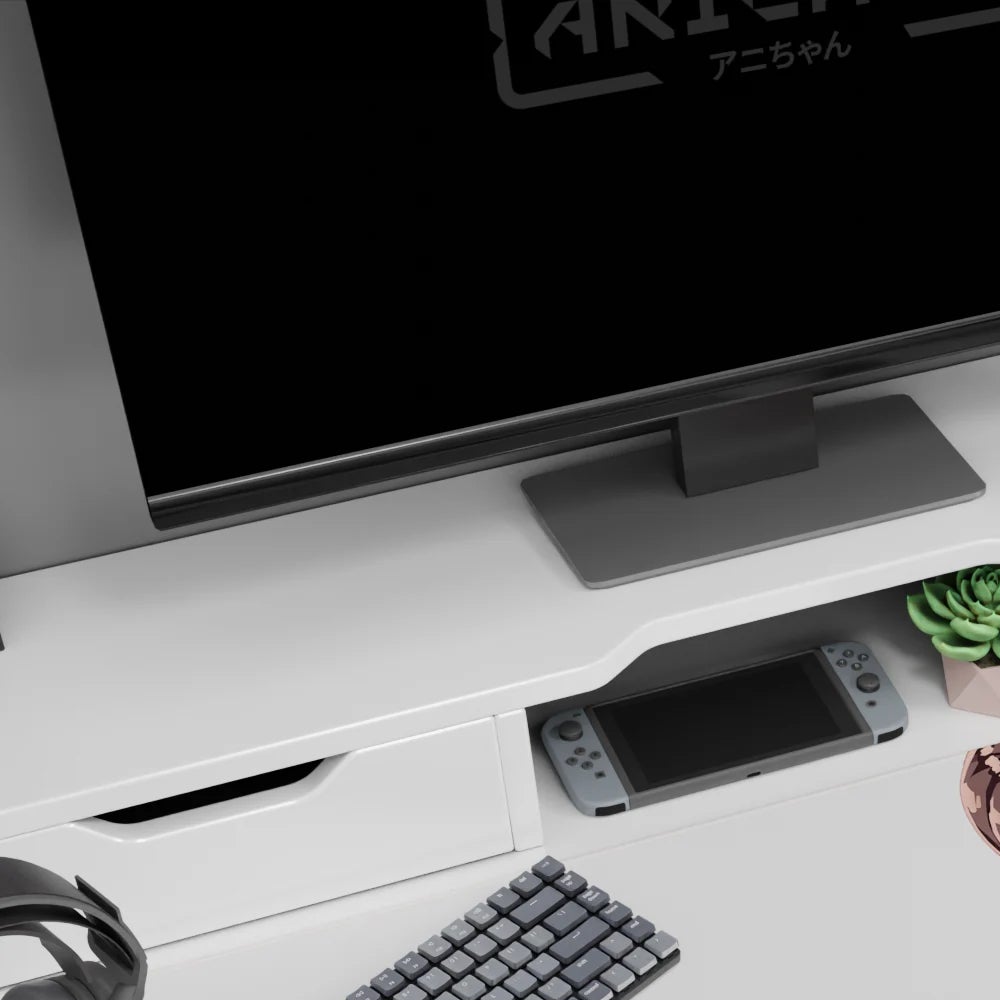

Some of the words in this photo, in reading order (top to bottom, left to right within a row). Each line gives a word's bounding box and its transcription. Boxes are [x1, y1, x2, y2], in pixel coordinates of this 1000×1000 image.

[709, 30, 852, 81] アニちゃん
